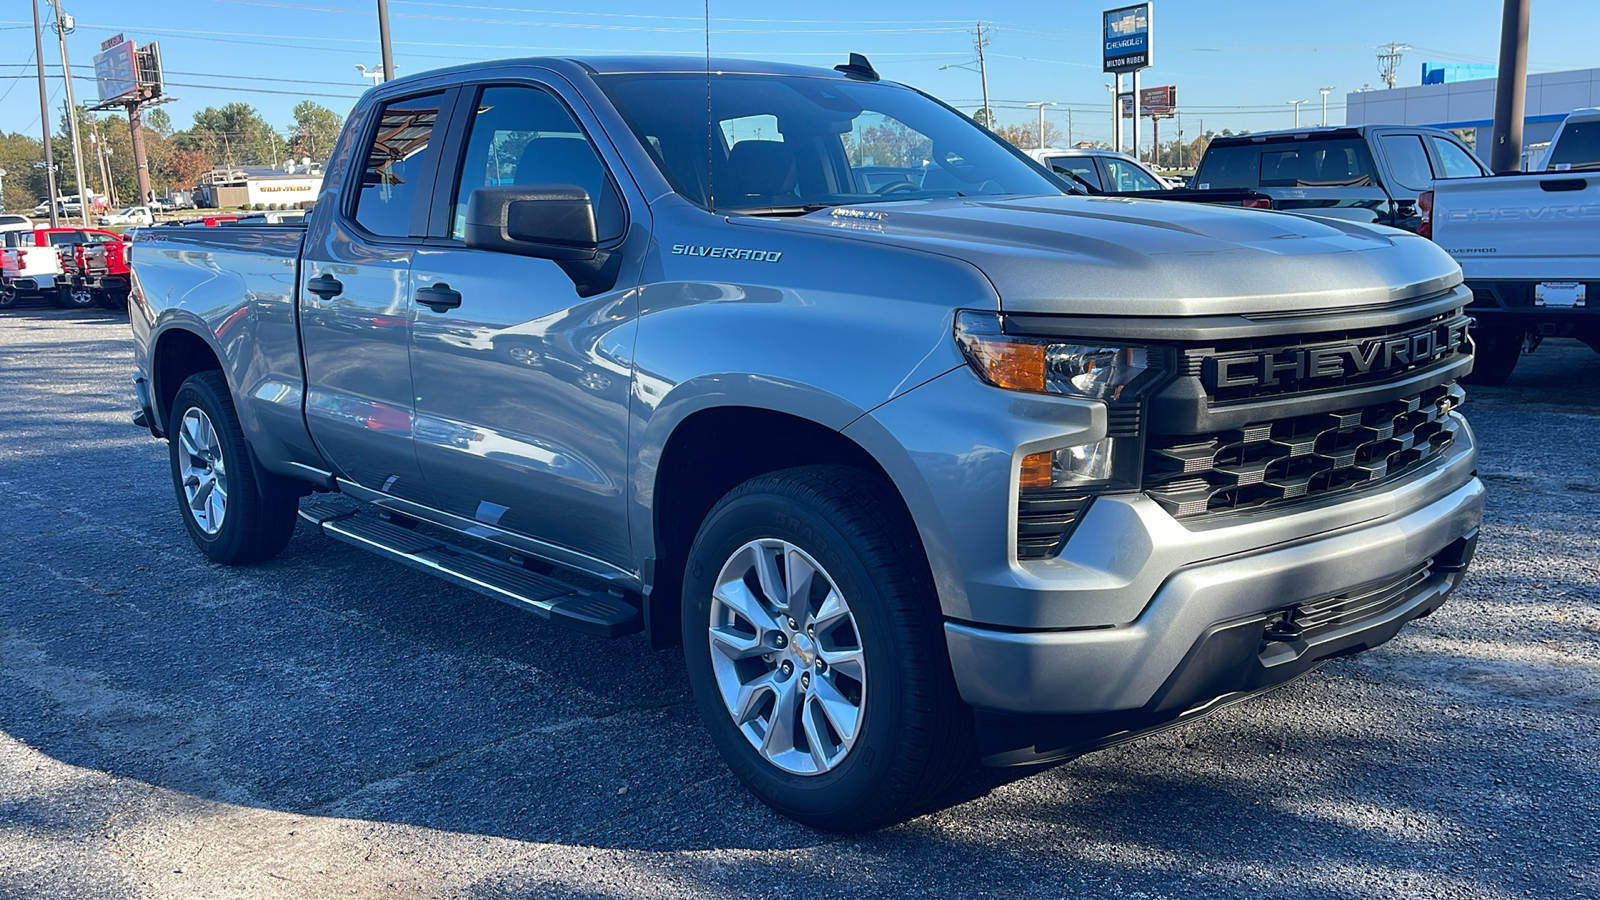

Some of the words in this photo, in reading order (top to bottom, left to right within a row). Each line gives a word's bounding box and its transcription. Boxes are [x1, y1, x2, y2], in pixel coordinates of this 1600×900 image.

[1106, 37, 1143, 50] CHEVROLET
[1106, 58, 1125, 68] MILTON
[1126, 55, 1145, 65] RUBEN
[671, 244, 783, 263] SILVERADO
[1216, 316, 1473, 388] CHEVROLET
